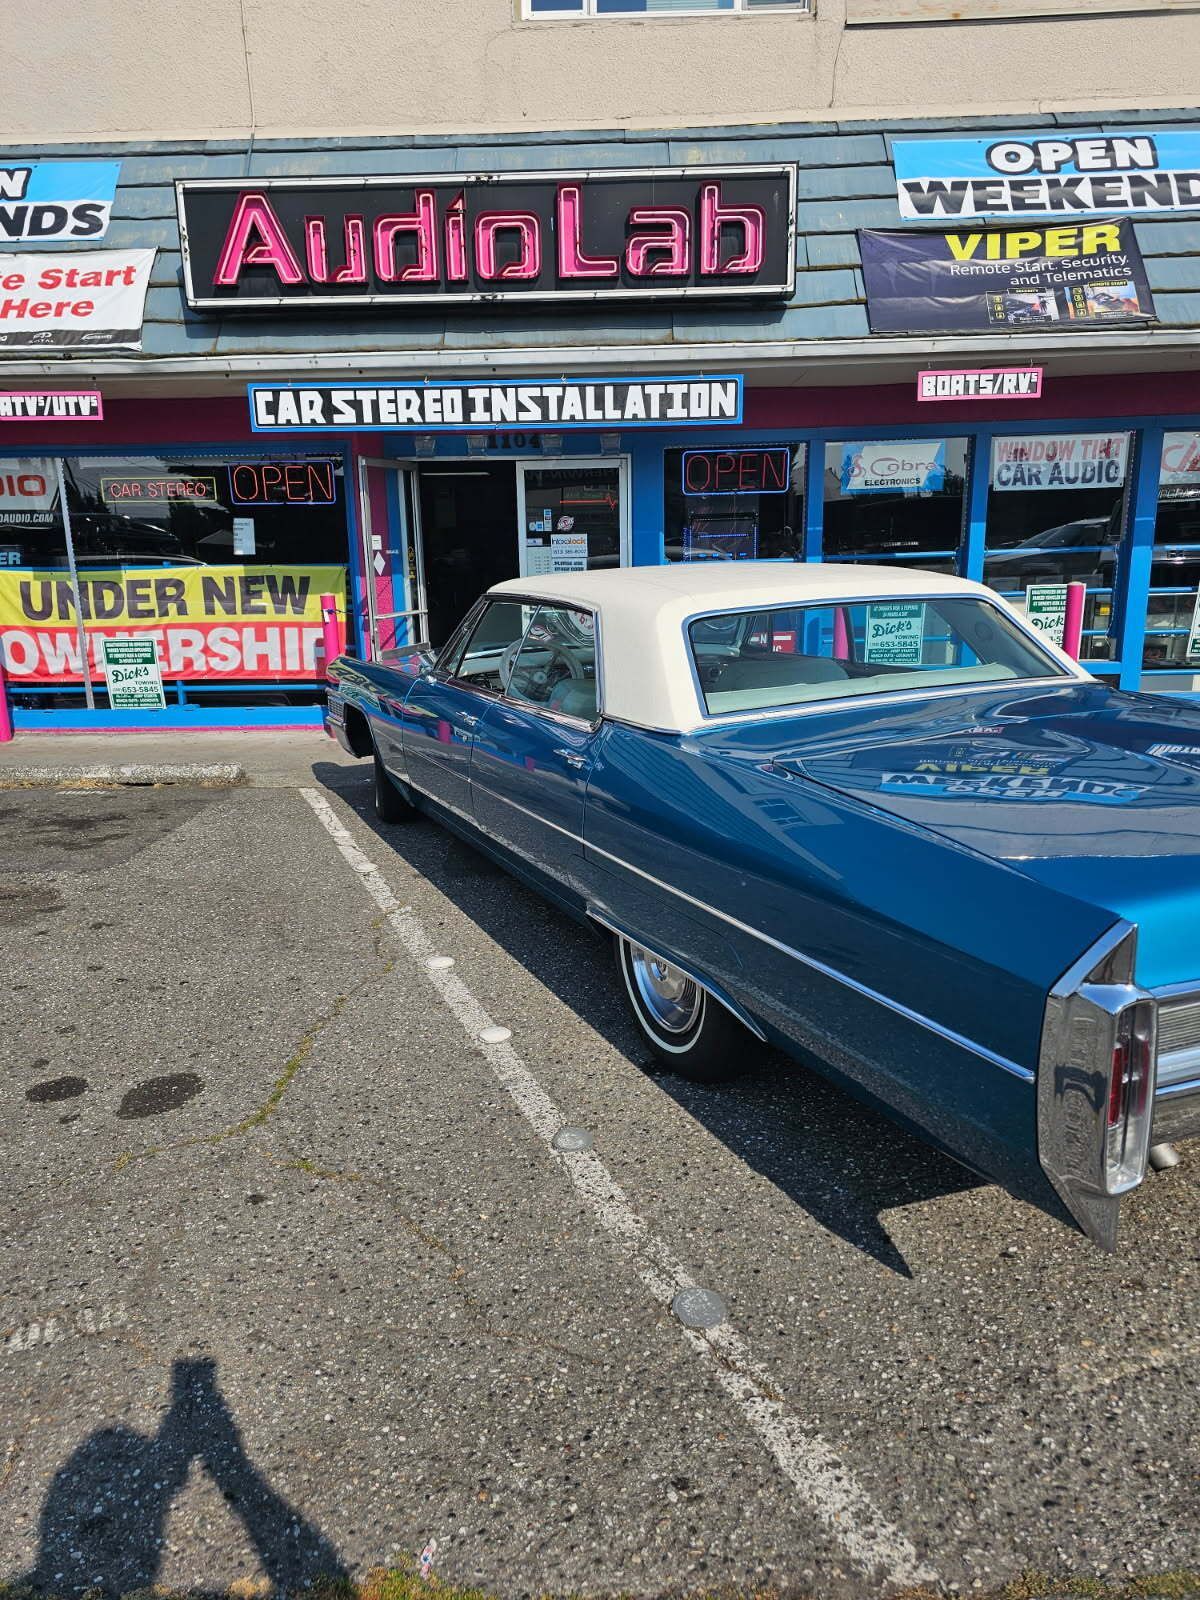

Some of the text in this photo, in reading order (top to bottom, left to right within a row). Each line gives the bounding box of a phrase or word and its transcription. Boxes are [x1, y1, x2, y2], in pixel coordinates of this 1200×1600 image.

[987, 137, 1158, 175] OPEN
[945, 224, 1121, 261] VIPER
[38, 266, 136, 291] Start
[950, 263, 1010, 276] Remote
[1010, 264, 1132, 285] and Telematics
[0, 298, 94, 319] Here
[255, 382, 736, 424] CAR STEREO INSTALLATION
[997, 438, 1125, 462] WINDOW TINT
[686, 453, 786, 491] OPEN
[870, 457, 938, 477] Cobra
[997, 460, 1120, 486] CAR AUDIO
[110, 481, 207, 498] CAR STEREO
[233, 465, 333, 501] OPEN
[864, 478, 921, 487] ELECTRONICS
[19, 575, 311, 621] UNDER NEW
[871, 620, 912, 638] Dick's
[112, 666, 149, 683] Dick's
